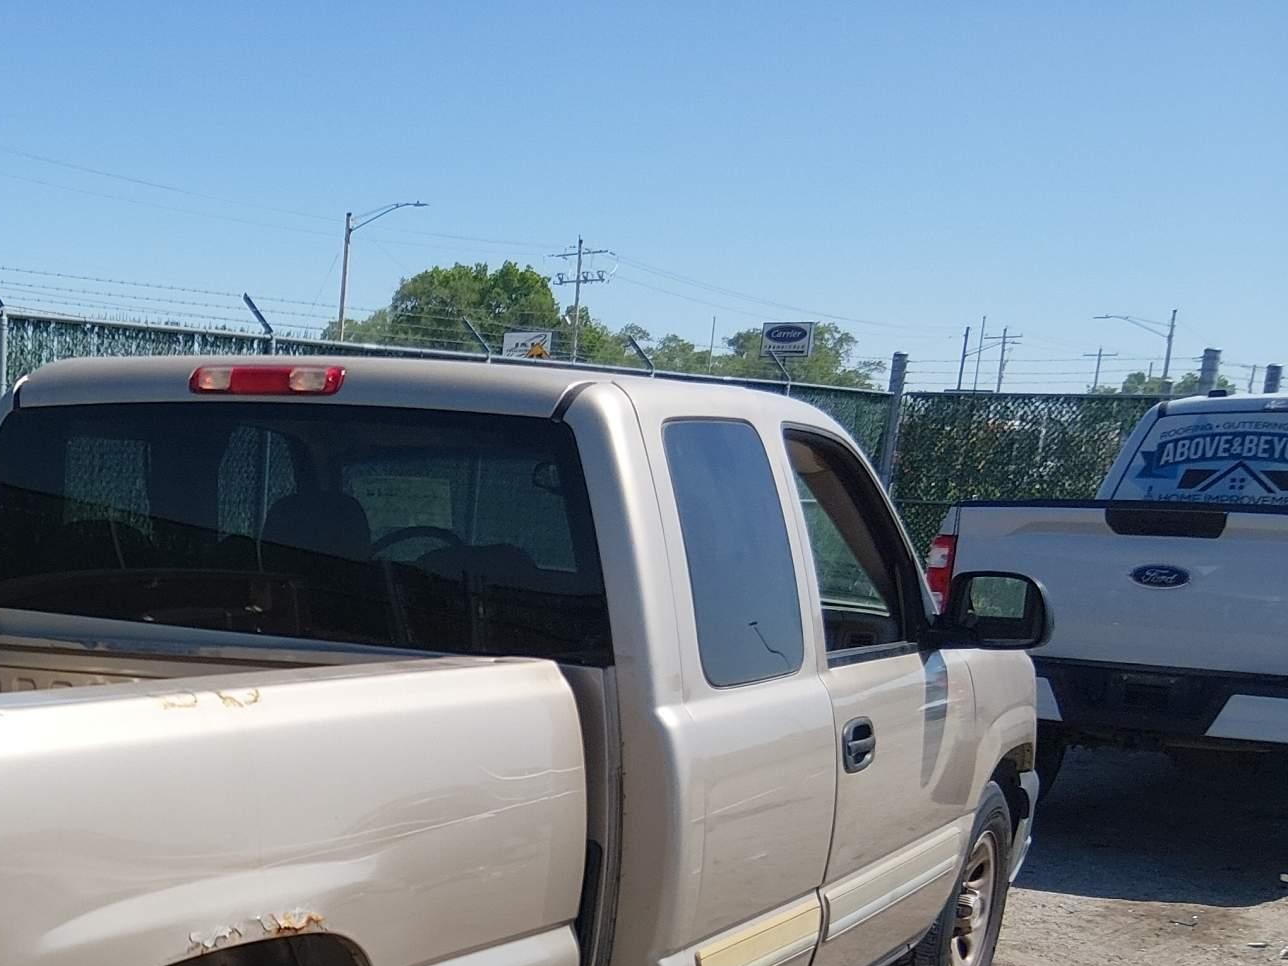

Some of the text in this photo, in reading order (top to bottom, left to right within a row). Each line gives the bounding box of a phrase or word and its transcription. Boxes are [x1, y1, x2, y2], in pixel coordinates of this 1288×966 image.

[771, 329, 802, 338] Carrier
[1159, 422, 1213, 439] ROOFING
[1158, 493, 1201, 503] HOME
[1142, 568, 1178, 583] Ford
